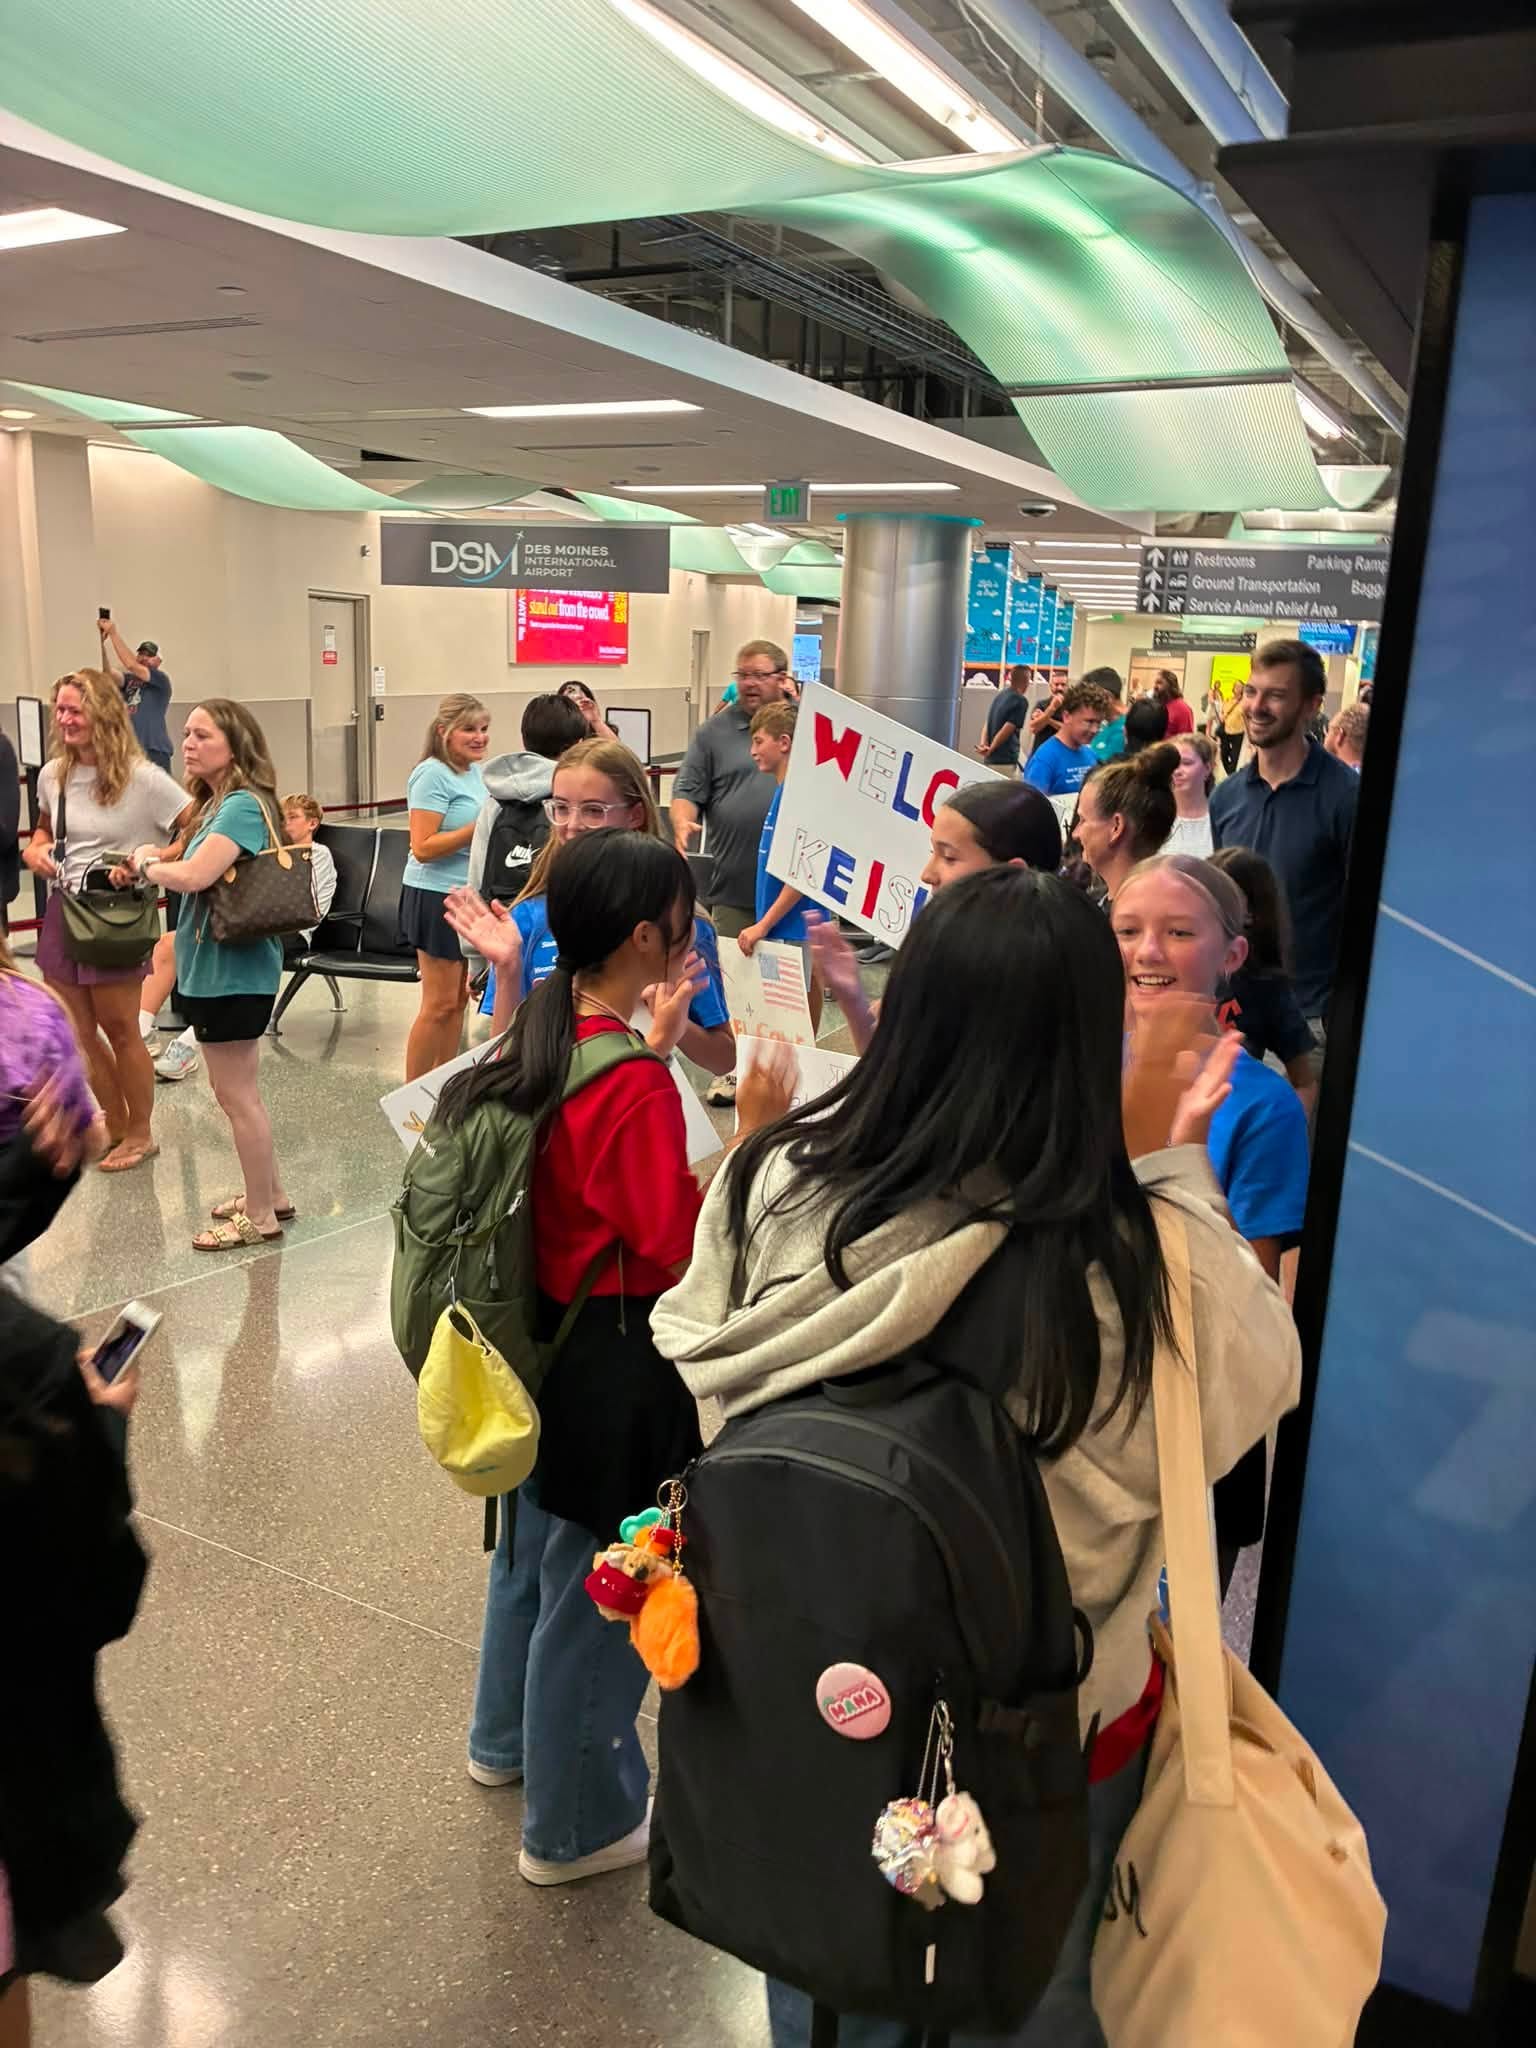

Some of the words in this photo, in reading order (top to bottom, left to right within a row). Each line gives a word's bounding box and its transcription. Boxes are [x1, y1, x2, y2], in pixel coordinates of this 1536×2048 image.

[430, 540, 519, 576] DSM
[524, 544, 552, 555] DES
[555, 544, 609, 557] MOINES
[1194, 551, 1256, 569] Restrooms
[524, 556, 617, 568] INTERNATIONAL
[524, 567, 574, 577] AIRPORT
[1307, 554, 1353, 575] Parking
[1191, 573, 1235, 591] Ground
[1237, 575, 1321, 596] Transportation
[577, 600, 588, 619] the
[1188, 597, 1232, 614] Service
[1233, 599, 1274, 616] Animal
[1275, 600, 1310, 617] Relief
[1310, 601, 1338, 618] Area
[814, 711, 978, 830] WELC
